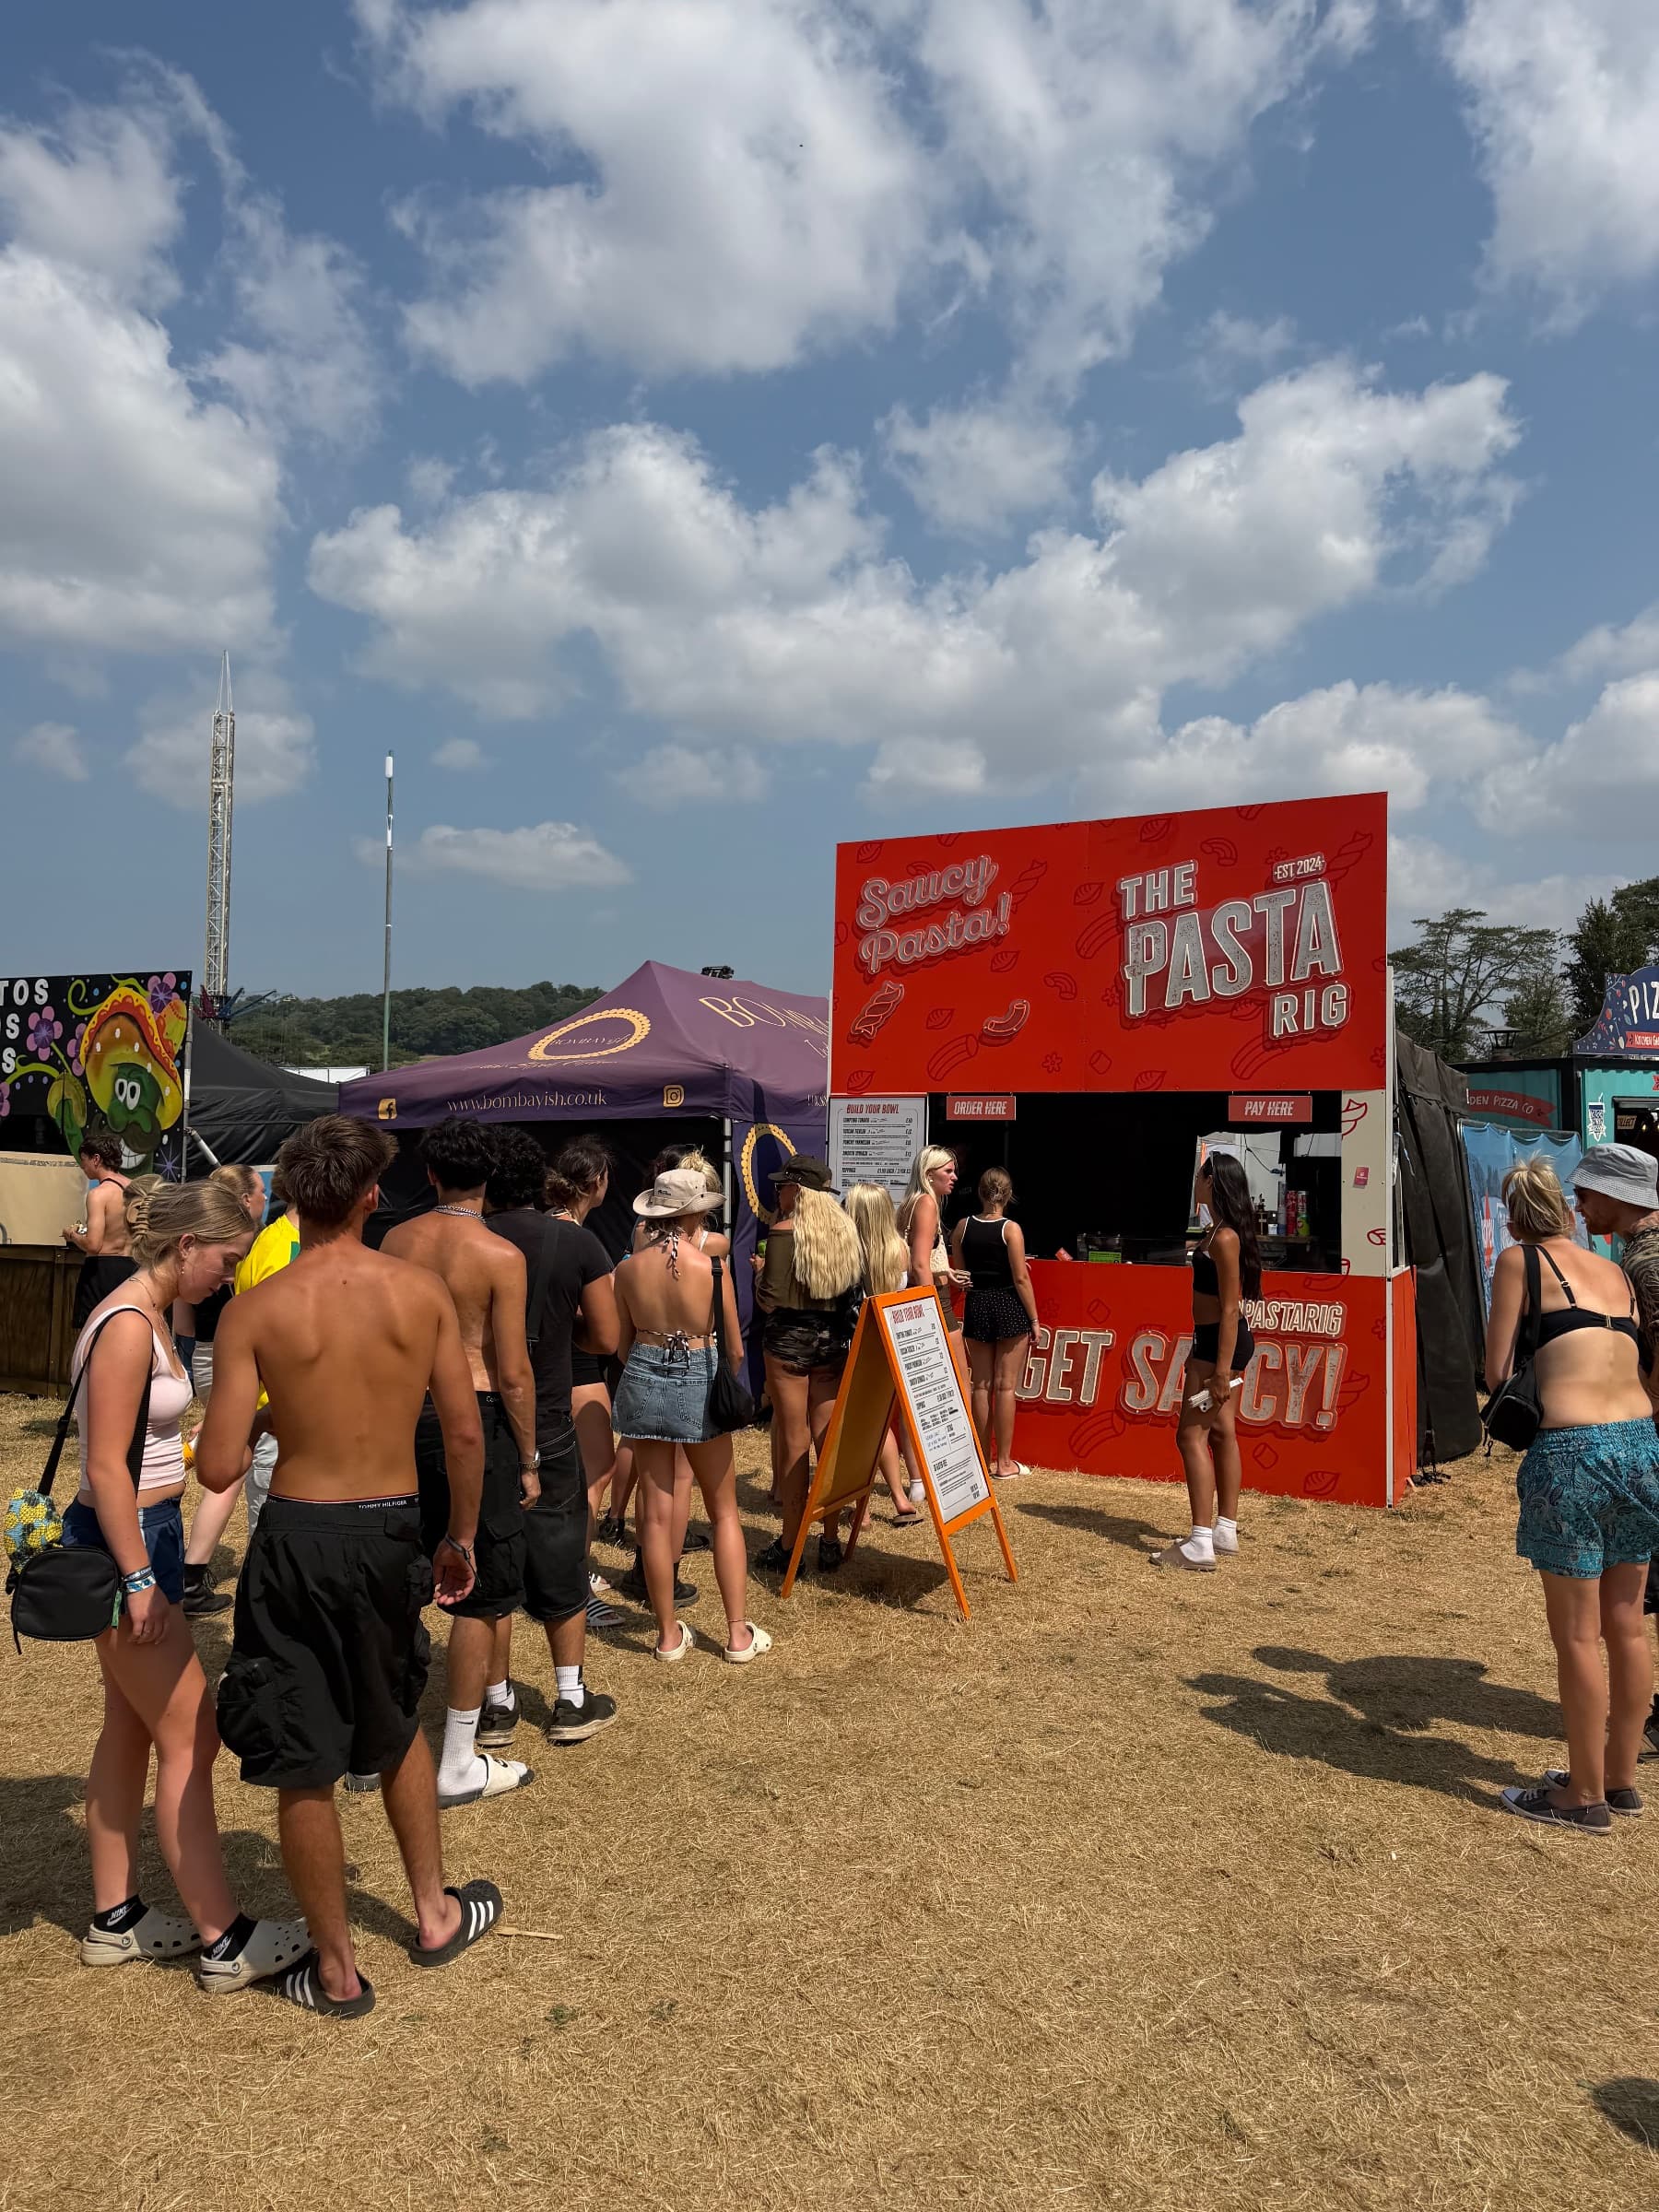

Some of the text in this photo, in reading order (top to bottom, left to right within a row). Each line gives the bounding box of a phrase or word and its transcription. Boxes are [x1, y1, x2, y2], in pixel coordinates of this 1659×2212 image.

[1277, 855, 1323, 878] EST 2024
[859, 855, 996, 928] Saucy
[1121, 863, 1195, 918] THE
[861, 892, 1011, 973] Pasta!
[1124, 881, 1341, 1015] PASTA
[1273, 983, 1347, 1037] RIG
[447, 1089, 607, 1112] www.bombayish.co.uk
[846, 1103, 900, 1114] BUILD YOUR BOWL
[953, 1100, 1007, 1115] ORDER HERE
[1244, 1100, 1294, 1116] PAY HERE
[1493, 1095, 1519, 1110] PIZZA
[1522, 1102, 1535, 1114] CO
[1239, 1299, 1343, 1335] PASTARIG
[1015, 1327, 1347, 1427] GET SACY!
[111, 1904, 129, 1920] NIKE
[213, 1936, 229, 1955] NIKE
